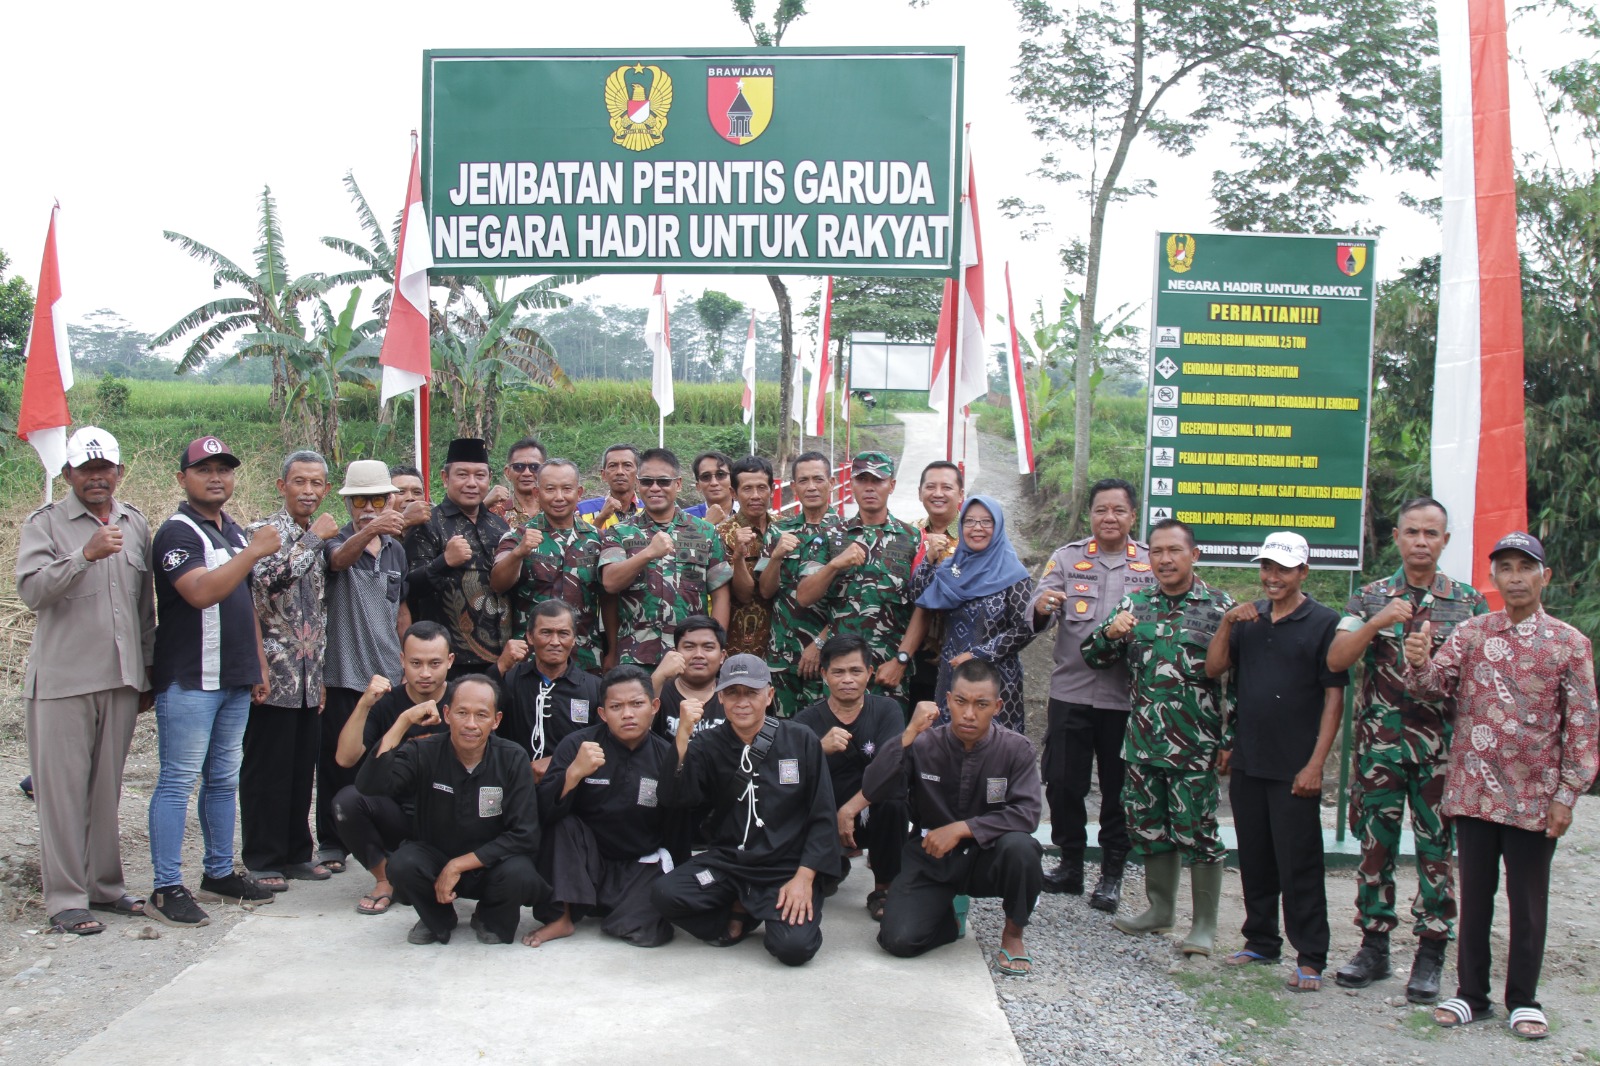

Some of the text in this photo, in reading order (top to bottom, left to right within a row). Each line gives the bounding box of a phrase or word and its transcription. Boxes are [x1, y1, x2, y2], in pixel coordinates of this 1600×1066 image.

[708, 68, 773, 77] BRAWIJAYA
[449, 160, 935, 206] JEMBATAN PERINTIS GARUDA
[435, 213, 950, 259] NEGARA HADIR UNTUK RAKYAT
[1168, 279, 1363, 297] NEGARA HADIR UNTUK RAKYAT
[1210, 303, 1320, 324] PERHATIAN!!!
[1183, 332, 1307, 349] KAPASITAS BEBAN MAKSIMAL 2,5 TON
[1182, 362, 1299, 379] KENDARAAN MELINTAS BERGANTIAN
[1181, 392, 1359, 411] DILARANG BERHENTI/PARKIR KENDARAAN DI JEMBATAN
[1180, 422, 1292, 438] KECEPATAN MAKSIMAL 10 KM/JAM
[1178, 451, 1207, 465] PEJALAN
[1207, 453, 1224, 465] KAKI
[1224, 453, 1257, 467] MELINTAS
[1258, 454, 1285, 467] DENGAN
[1285, 455, 1318, 469] HATI-HATI
[1177, 481, 1201, 494] ORANG
[1202, 482, 1216, 495] TUA
[1216, 483, 1239, 496] AWASI
[1239, 484, 1278, 497] ANAK-ANAK
[1278, 485, 1295, 498] SAAT
[1295, 486, 1330, 499] MELINTASI
[1176, 511, 1202, 524] SEGERA
[1202, 512, 1224, 525] LAPOR
[1224, 513, 1252, 526] PEMDES
[1252, 514, 1281, 527] APABILA
[1281, 515, 1295, 527] ADA
[1295, 515, 1336, 529] KERUSAKAN
[695, 542, 707, 550] AD
[1198, 544, 1238, 555] PERINTIS
[1309, 548, 1359, 560] INDONESIA
[1124, 576, 1154, 584] POLRI
[1186, 619, 1218, 632] TNI AD
